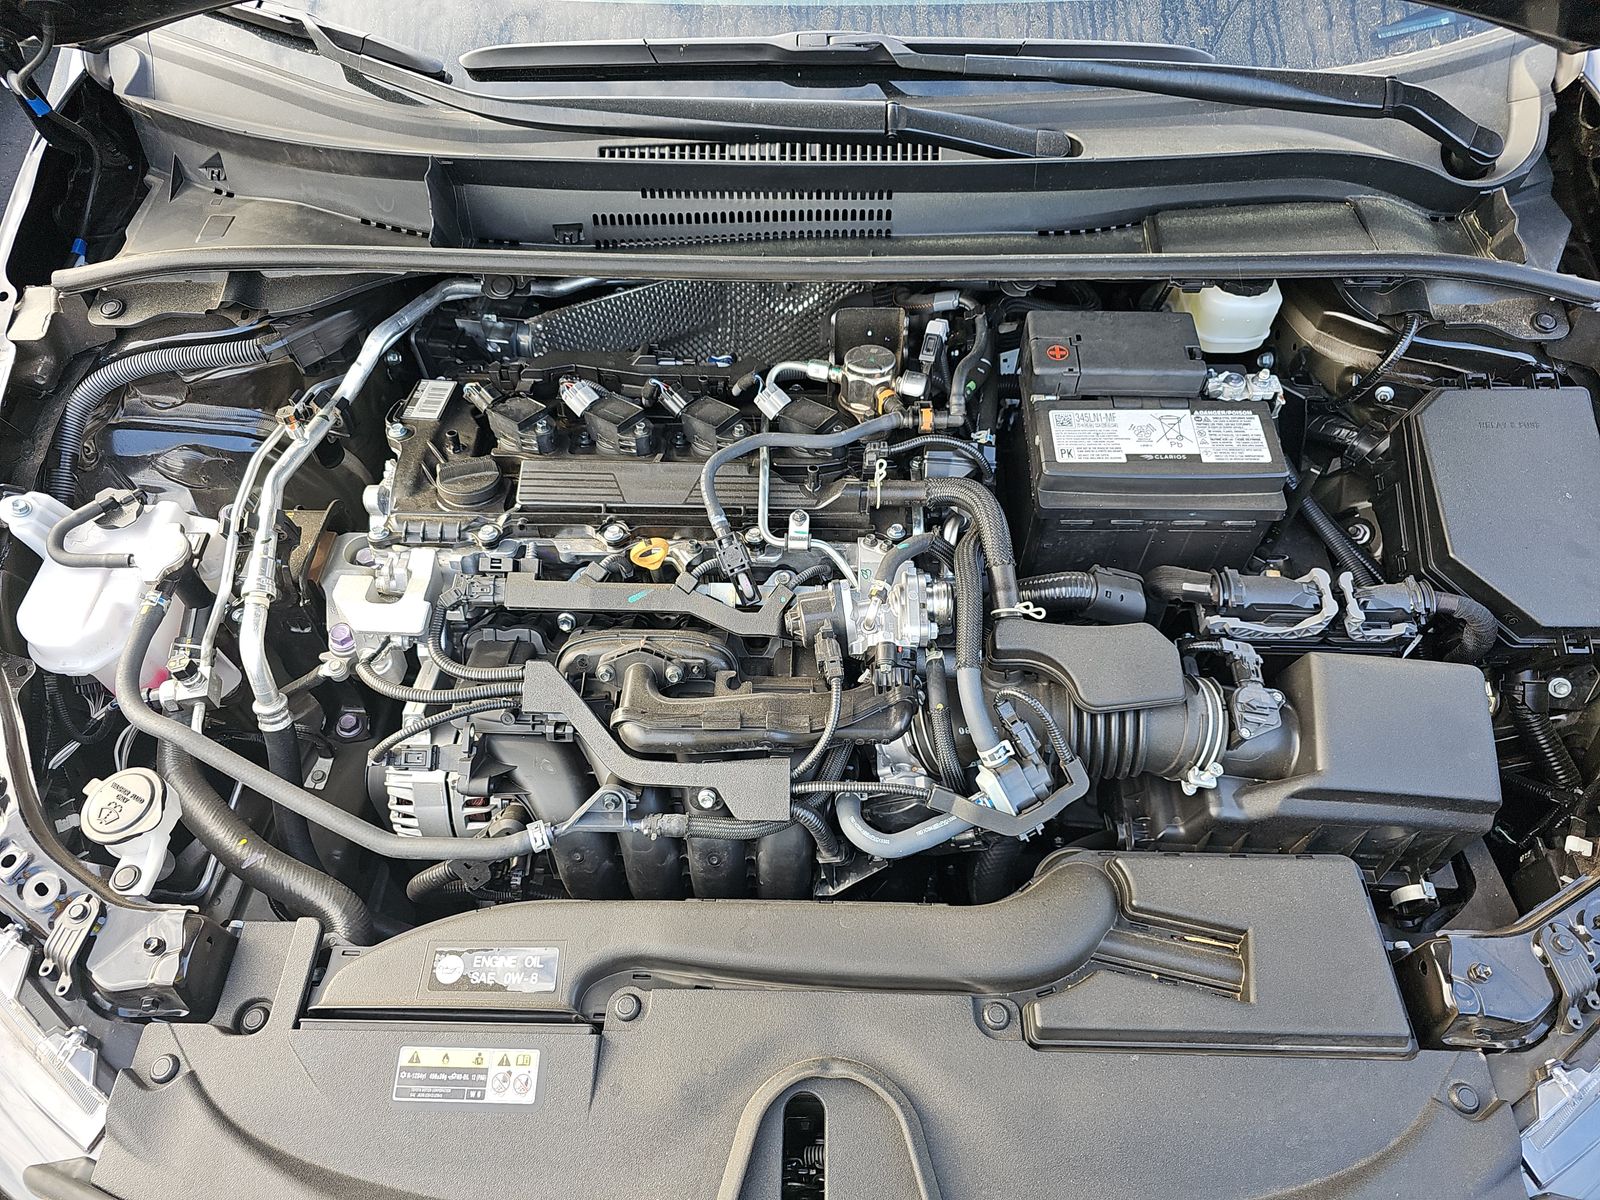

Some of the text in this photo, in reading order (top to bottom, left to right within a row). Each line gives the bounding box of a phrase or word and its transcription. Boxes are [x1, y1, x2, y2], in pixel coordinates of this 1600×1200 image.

[1075, 412, 1117, 423] 345LN1-MF
[1170, 440, 1184, 448] Pb
[1060, 448, 1074, 459] PK
[473, 955, 545, 968] ENGINE OIL
[470, 972, 539, 985] SAE 0W-8
